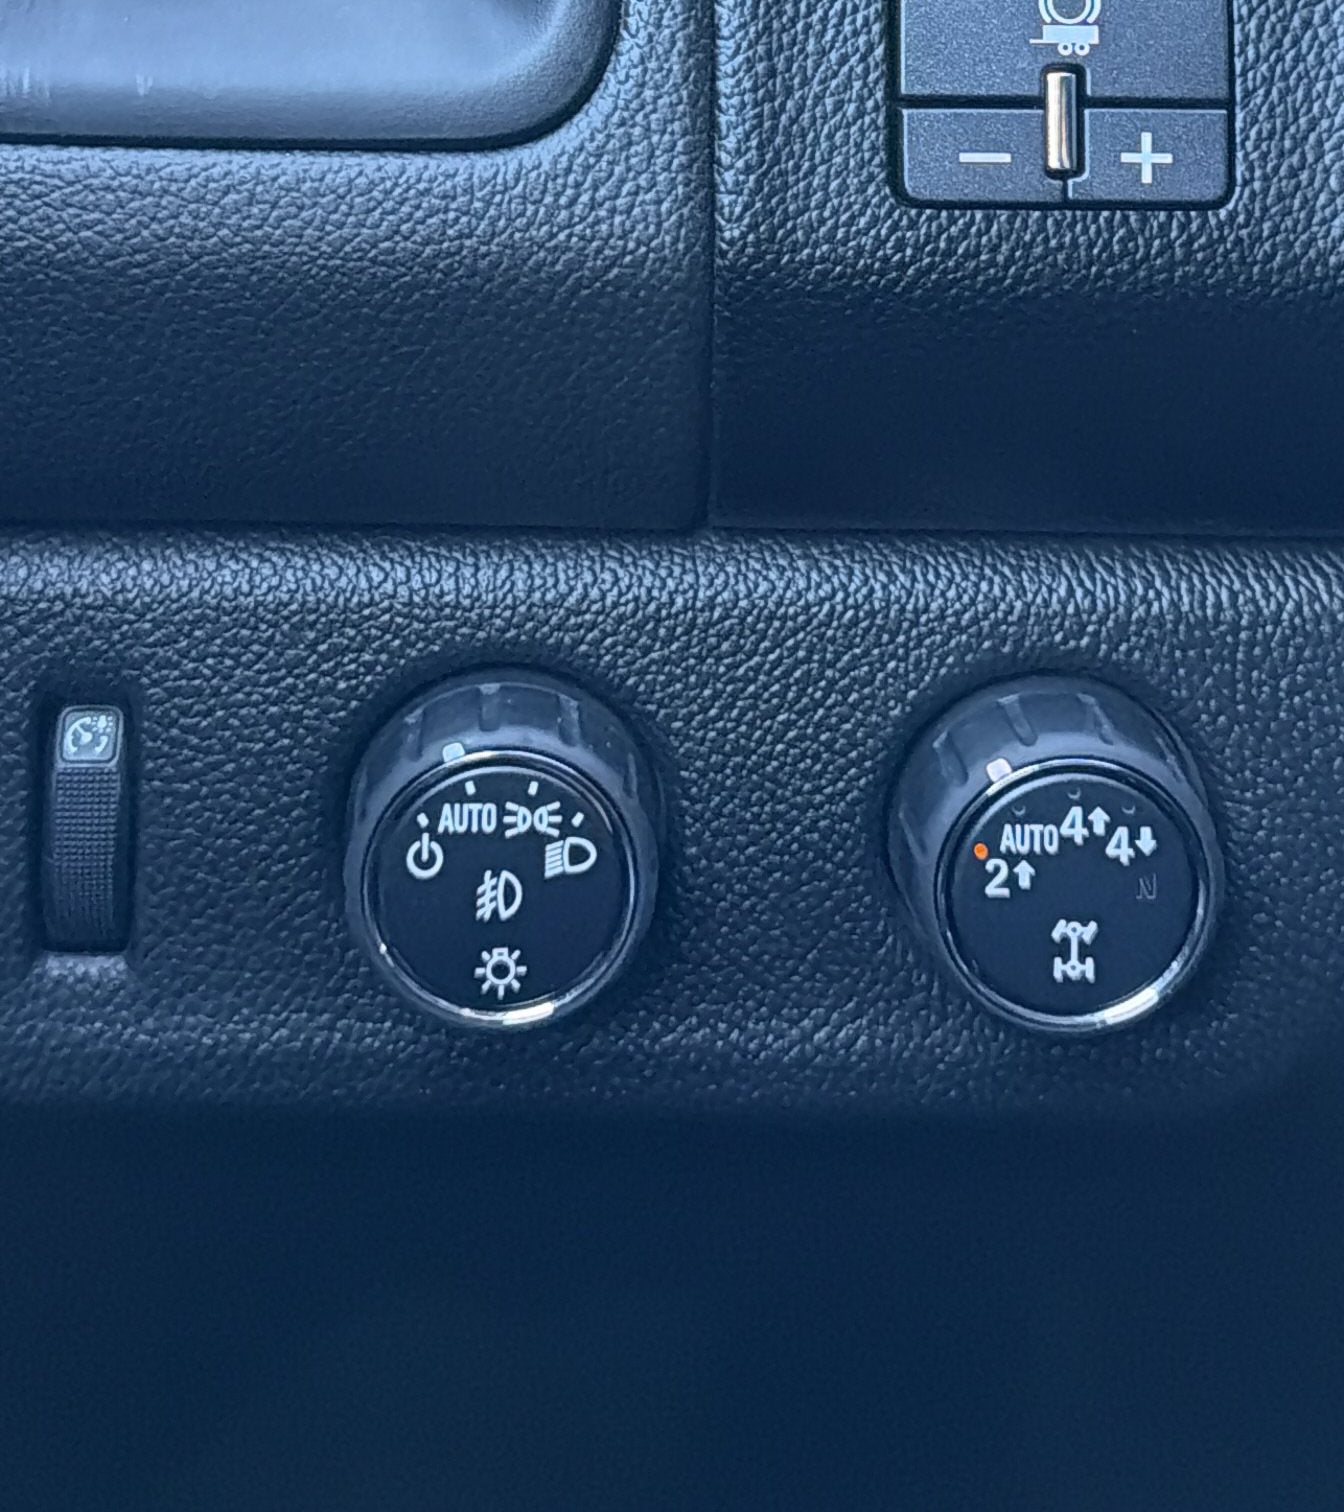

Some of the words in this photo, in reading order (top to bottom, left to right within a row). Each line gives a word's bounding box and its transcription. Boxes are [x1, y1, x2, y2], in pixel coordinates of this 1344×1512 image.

[437, 803, 497, 835] AUTO
[999, 823, 1059, 855] AUTO
[1059, 805, 1089, 846] 4
[1106, 825, 1135, 866] 4
[984, 857, 1011, 899] 2
